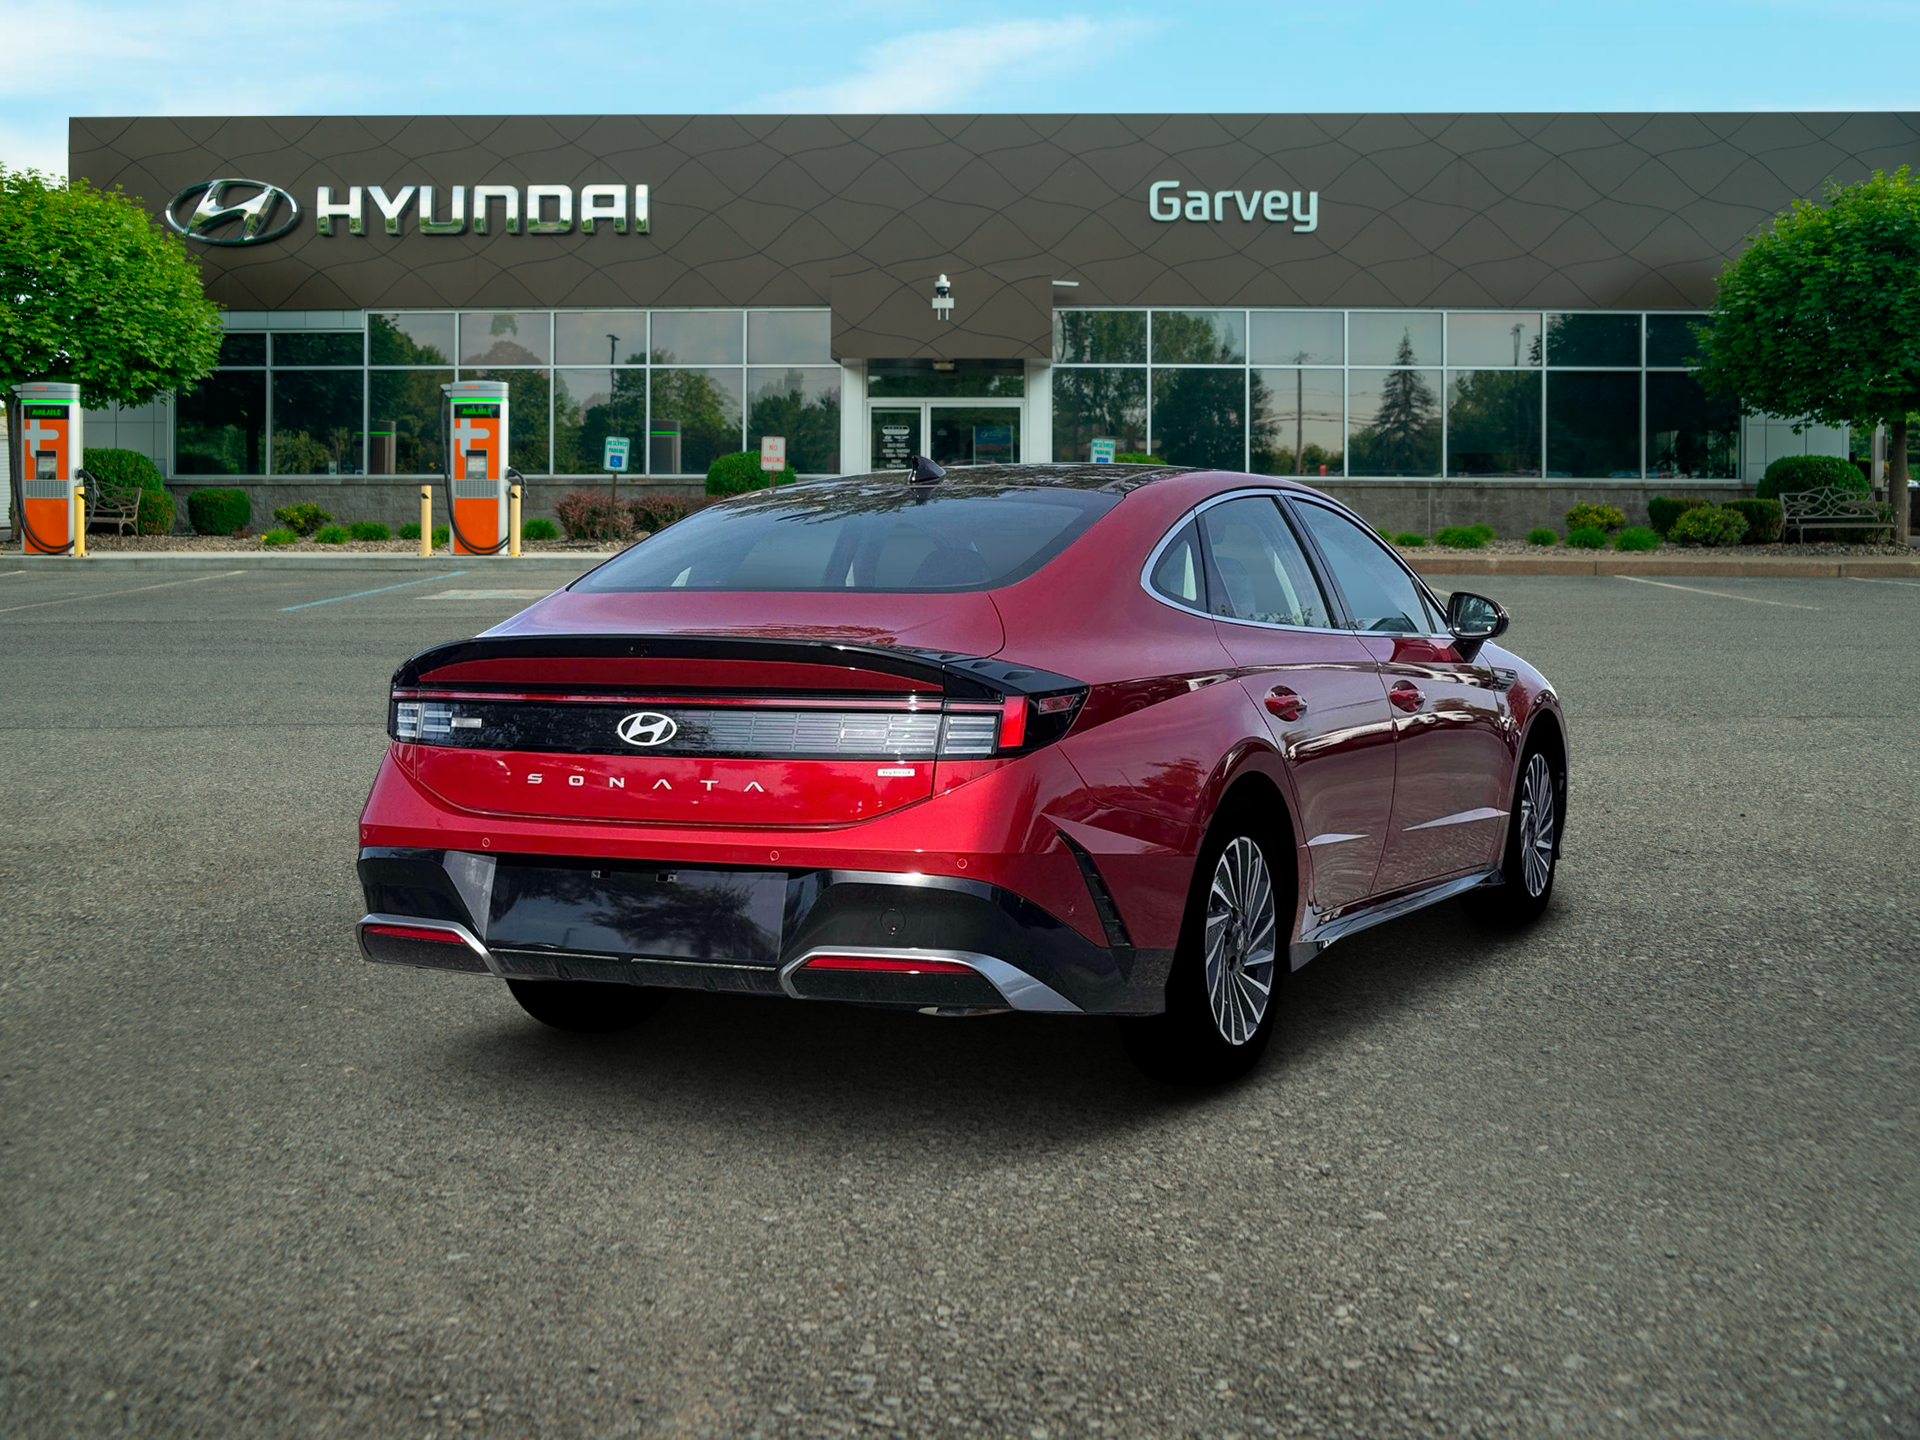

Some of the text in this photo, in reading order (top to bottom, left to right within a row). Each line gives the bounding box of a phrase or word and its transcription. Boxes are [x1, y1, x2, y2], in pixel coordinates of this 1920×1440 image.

[316, 184, 651, 236] HYUNDAI
[1149, 180, 1319, 233] Garvey
[31, 408, 61, 416] AVAILABLE
[461, 407, 492, 415] AVAILABLE
[527, 772, 765, 793] SONATA
